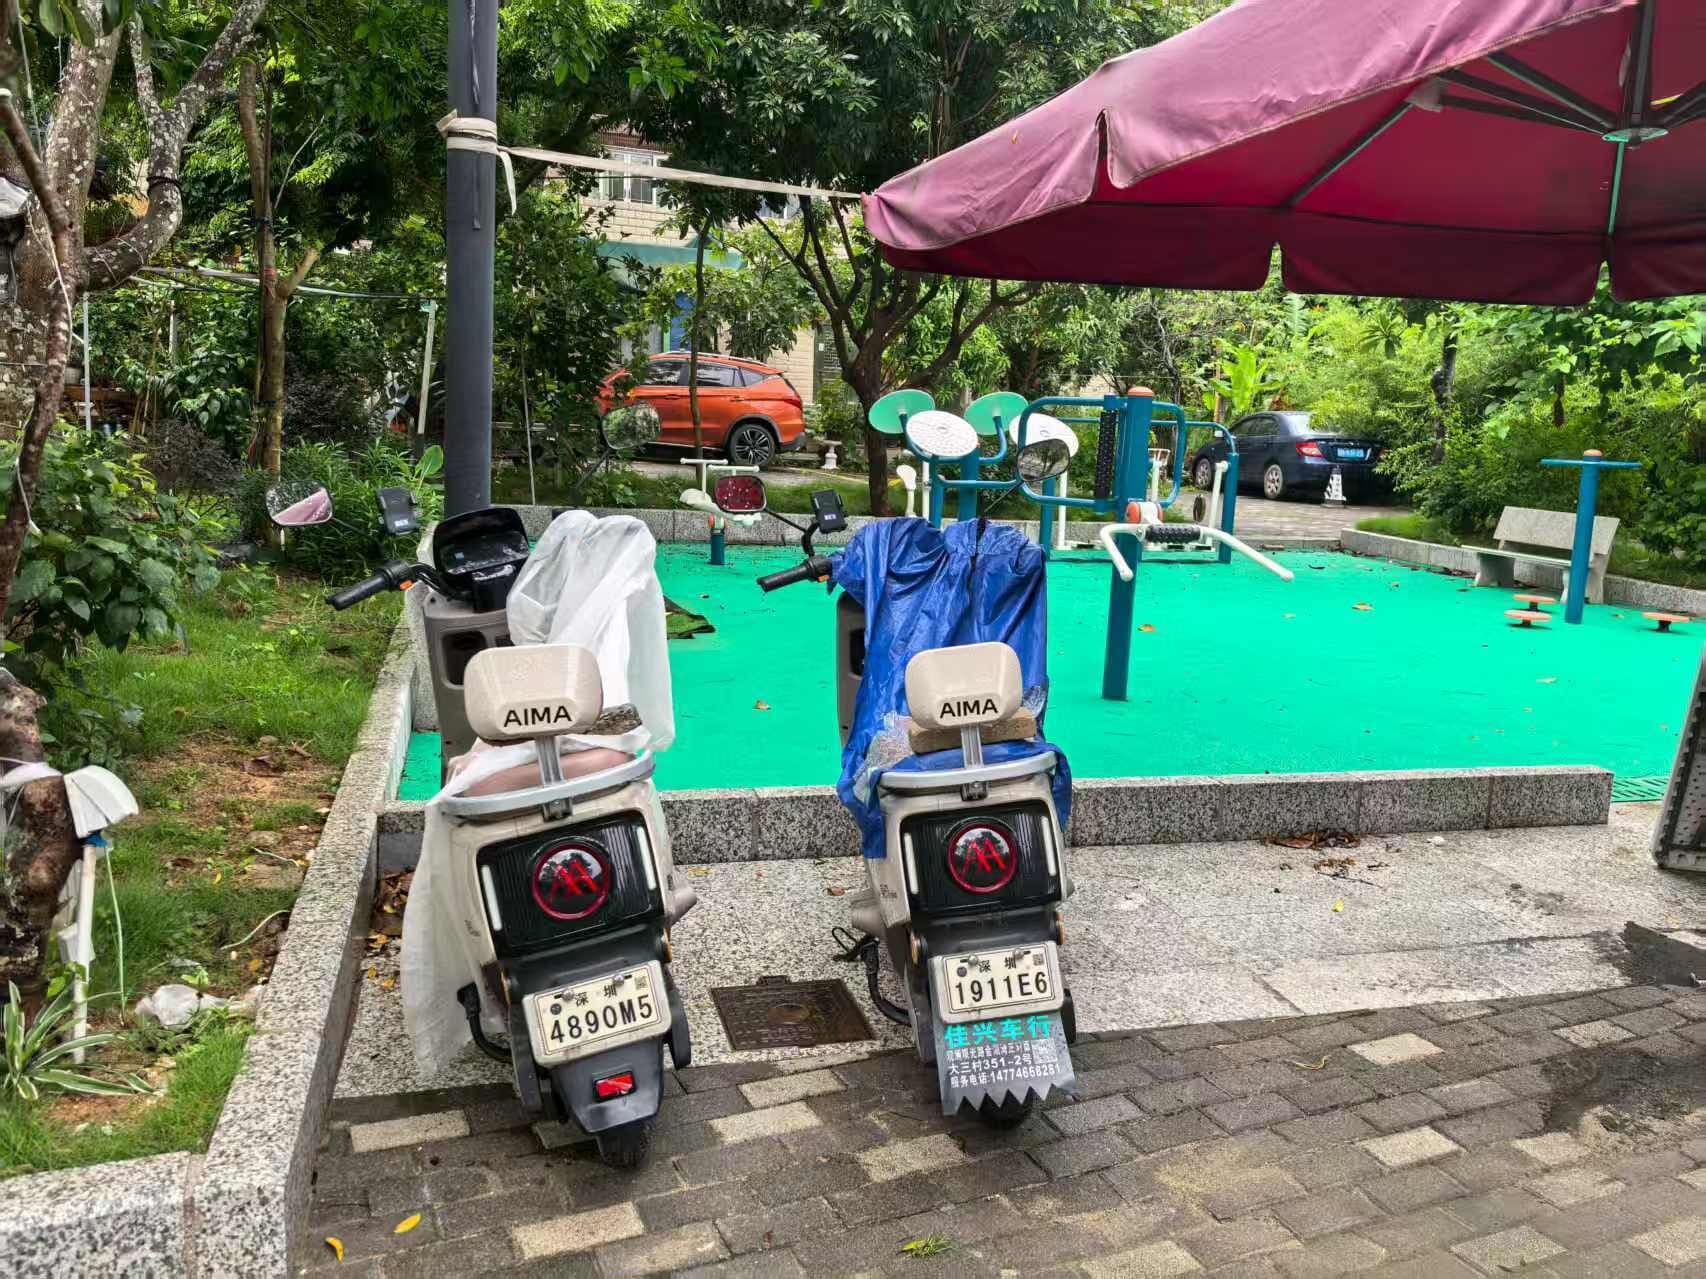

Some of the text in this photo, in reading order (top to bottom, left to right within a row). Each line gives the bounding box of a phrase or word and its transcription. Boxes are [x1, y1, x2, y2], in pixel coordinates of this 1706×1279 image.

[503, 705, 572, 728] AIMA
[940, 699, 998, 719] AIMA
[978, 957, 1017, 973] 深圳
[575, 984, 617, 1007] 深圳
[955, 971, 1047, 1004] 1911E6
[550, 994, 652, 1043] 4890M5
[944, 1015, 1050, 1048] 佳兴车行
[948, 1053, 1032, 1076] 大三村351-2号
